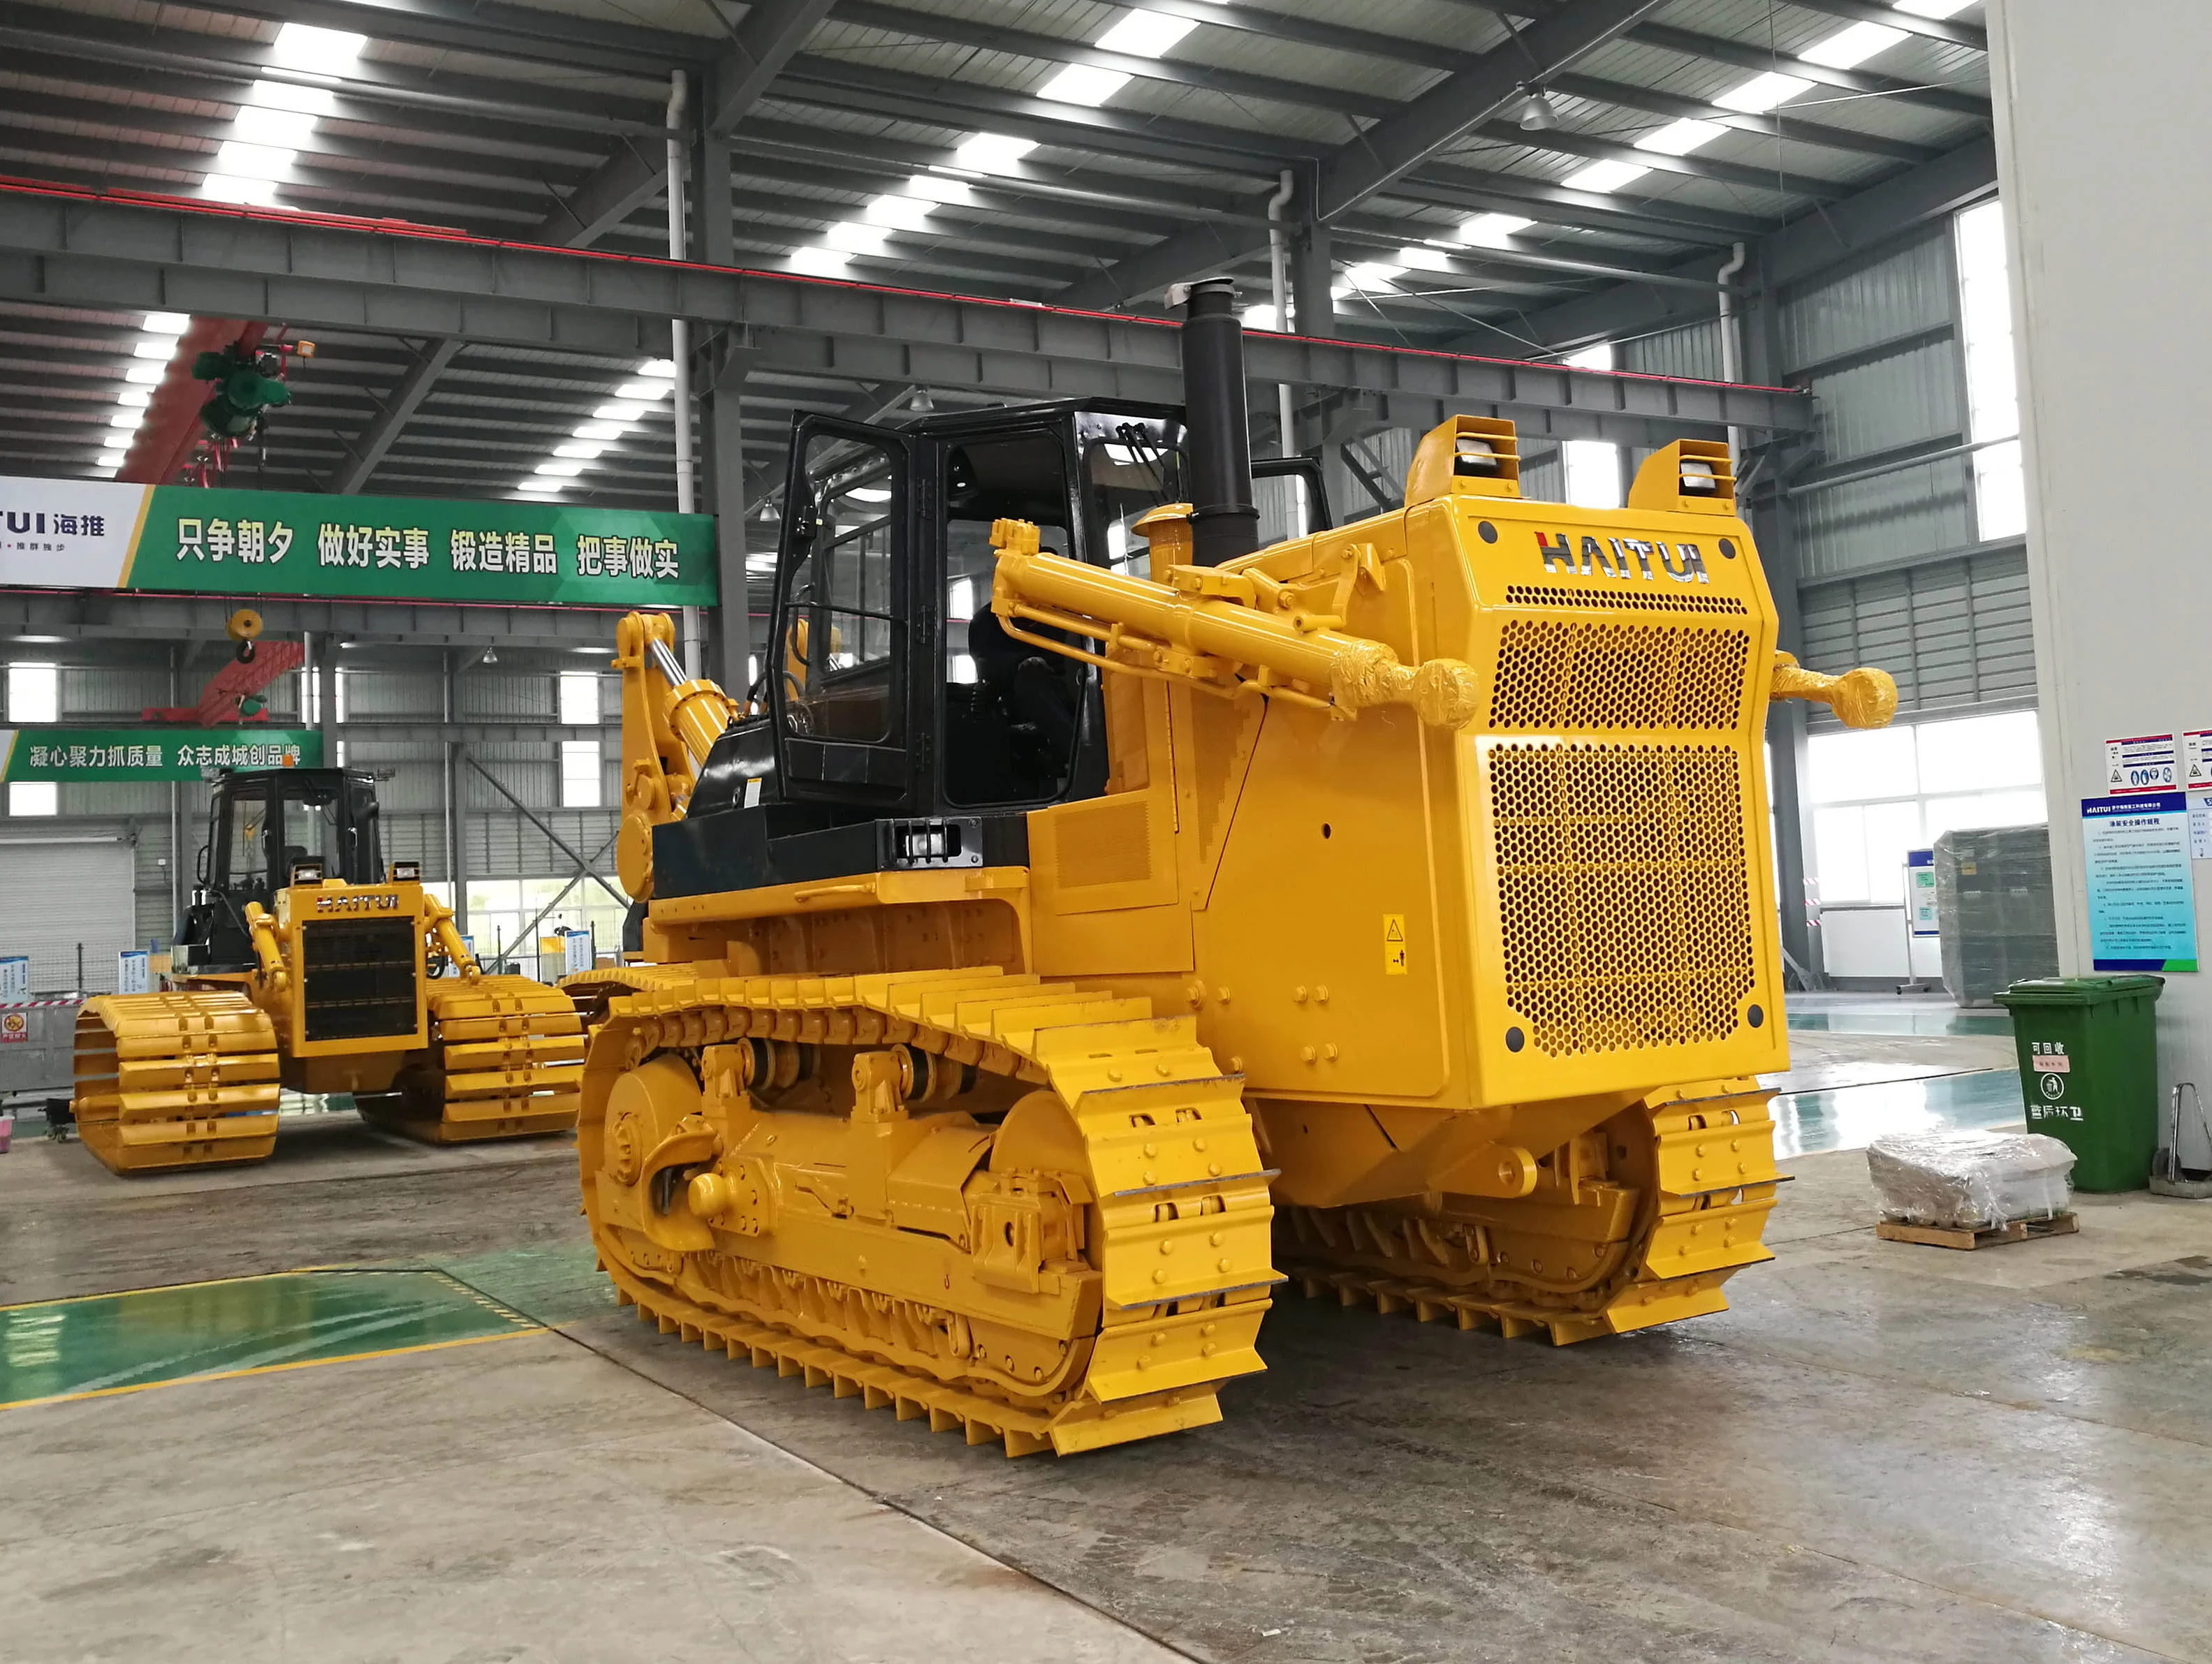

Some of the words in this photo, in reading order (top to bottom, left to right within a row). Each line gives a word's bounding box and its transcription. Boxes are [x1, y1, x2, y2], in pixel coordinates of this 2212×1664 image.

[0, 511, 45, 533] UI
[54, 513, 104, 536] 海推
[176, 517, 293, 563] 只争朝夕
[317, 523, 429, 568] 做好实事
[450, 529, 557, 574] 锻造精品
[576, 535, 679, 579] 把事做实
[1535, 531, 1709, 584] HAITUI
[29, 744, 163, 767] 凝心聚力抓质量
[177, 744, 301, 767] 众志成城创品牌
[316, 894, 399, 913] HAITUI
[2031, 1042, 2065, 1054] 可回收
